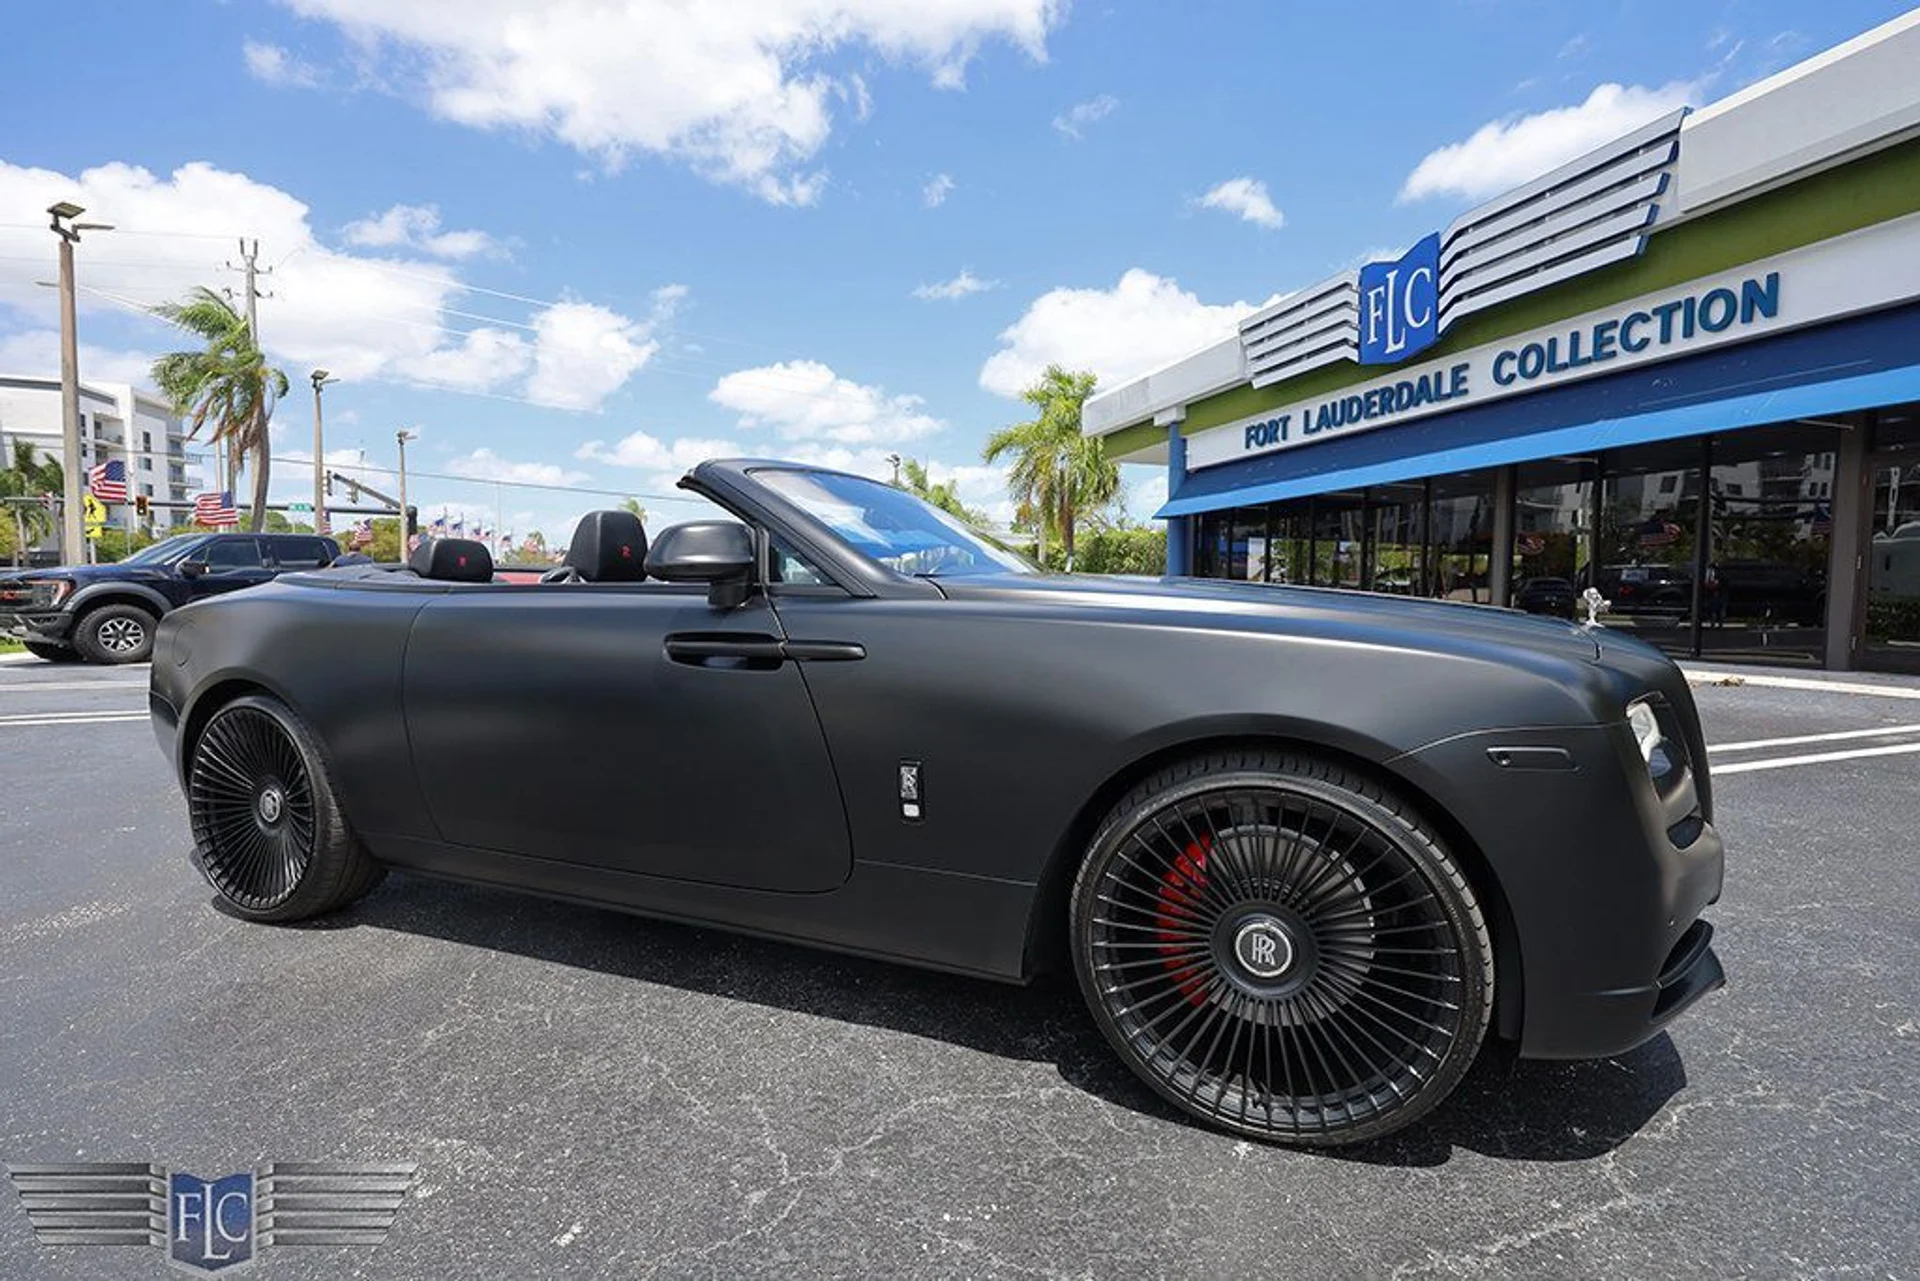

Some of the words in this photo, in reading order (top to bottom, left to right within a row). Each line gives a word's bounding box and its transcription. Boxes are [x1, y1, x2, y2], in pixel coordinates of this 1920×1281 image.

[1245, 415, 1291, 449] FORT
[1303, 363, 1470, 434] LAUDERDALE
[1492, 272, 1780, 386] COLLECTION
[1367, 267, 1431, 353] FLC
